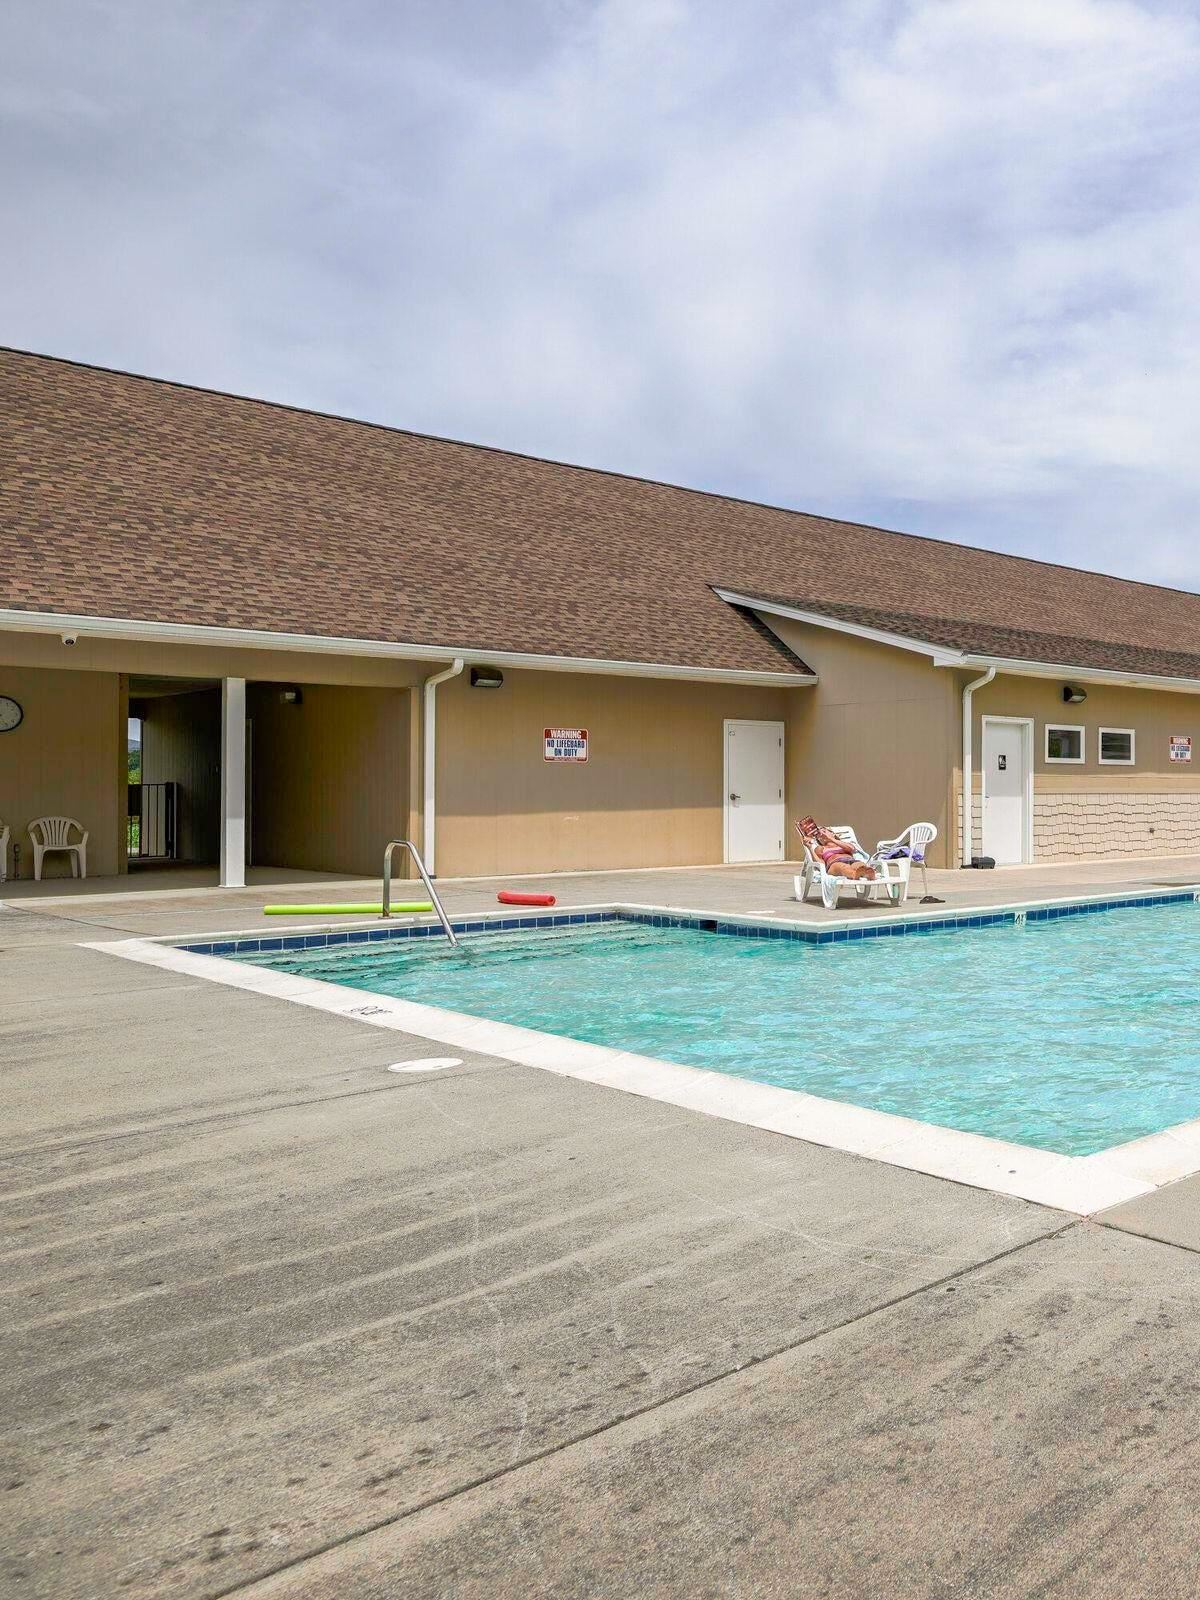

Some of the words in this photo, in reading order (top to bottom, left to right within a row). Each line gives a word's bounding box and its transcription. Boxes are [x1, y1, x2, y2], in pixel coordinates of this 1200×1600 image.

[550, 730, 581, 739] WARNING
[557, 740, 585, 748] LIFEGUARD
[555, 748, 562, 756] ON
